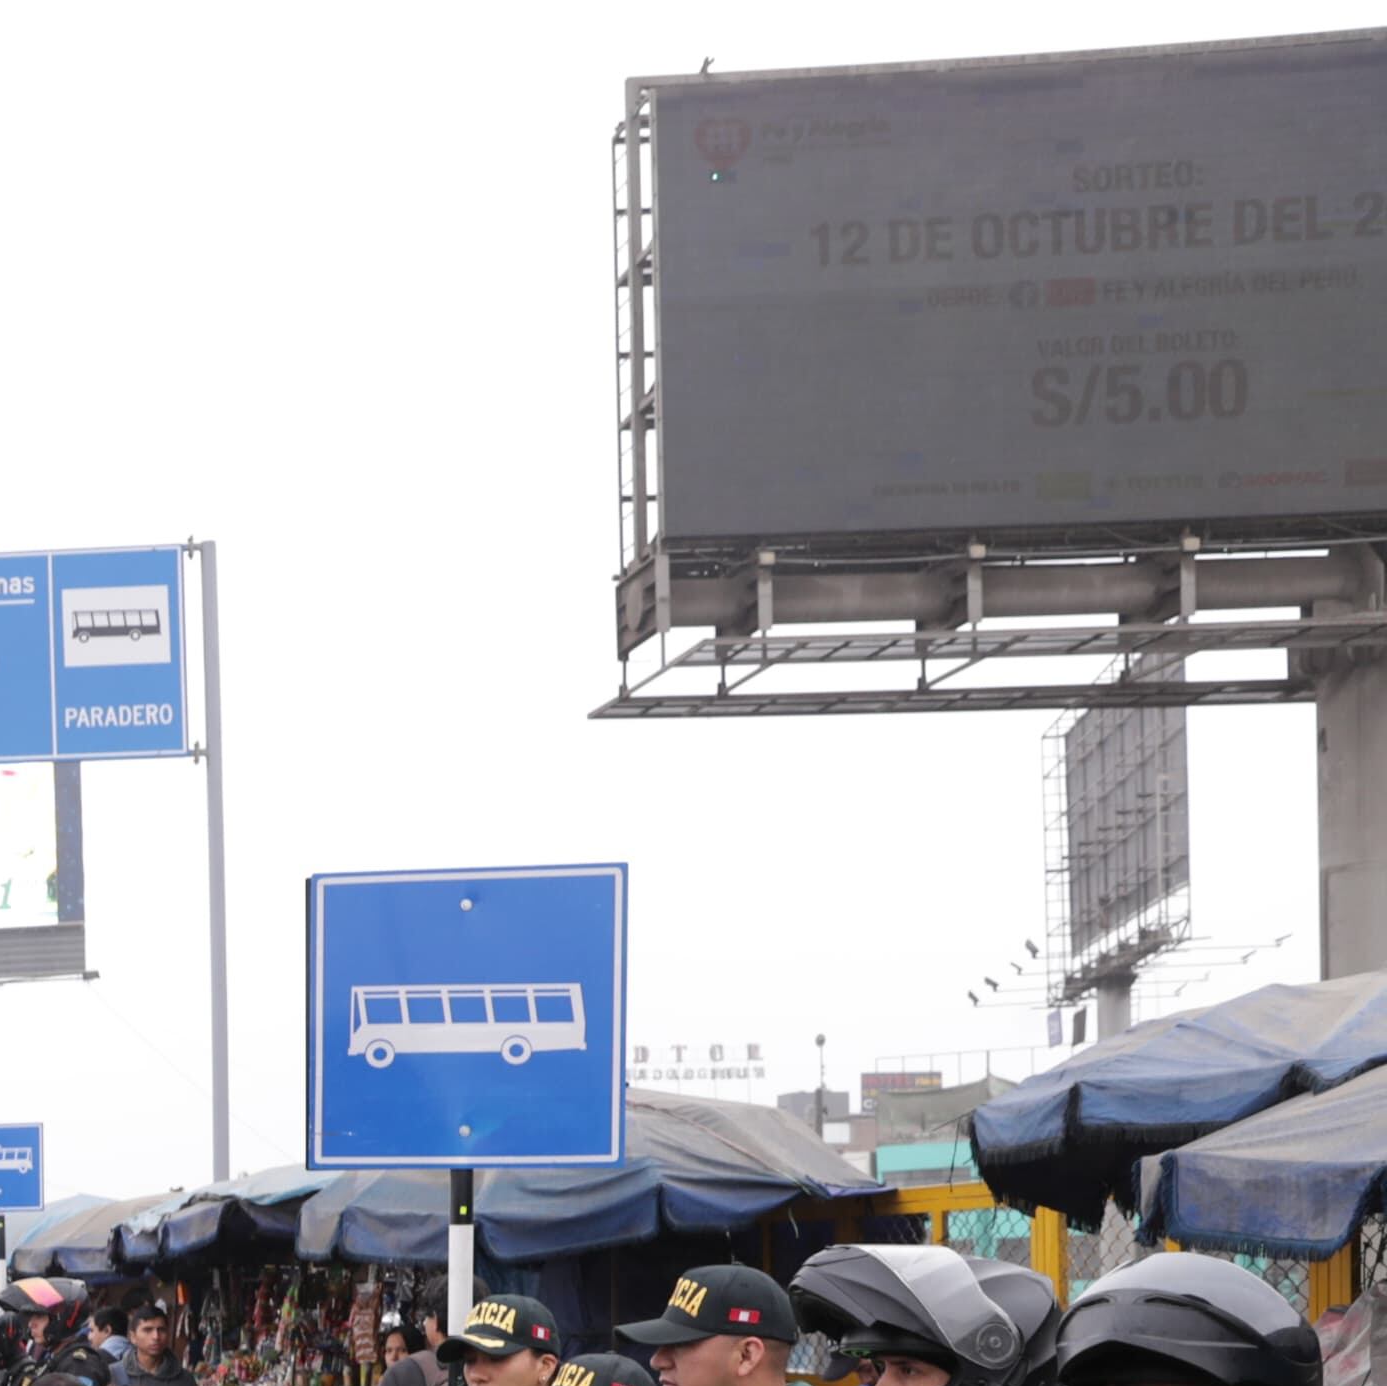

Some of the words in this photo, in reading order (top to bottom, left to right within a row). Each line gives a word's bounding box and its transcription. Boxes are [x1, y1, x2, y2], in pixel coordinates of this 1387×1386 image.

[1072, 160, 1205, 193] SORTEO:
[810, 219, 871, 268] 12
[888, 215, 955, 264] DE
[971, 202, 1213, 260] OCTUBRE
[1233, 195, 1334, 246] DEL
[1036, 335, 1105, 360] VALOR
[1111, 333, 1147, 356] DEL
[1031, 357, 1250, 430] S/5.00
[64, 702, 174, 729] PARADERO
